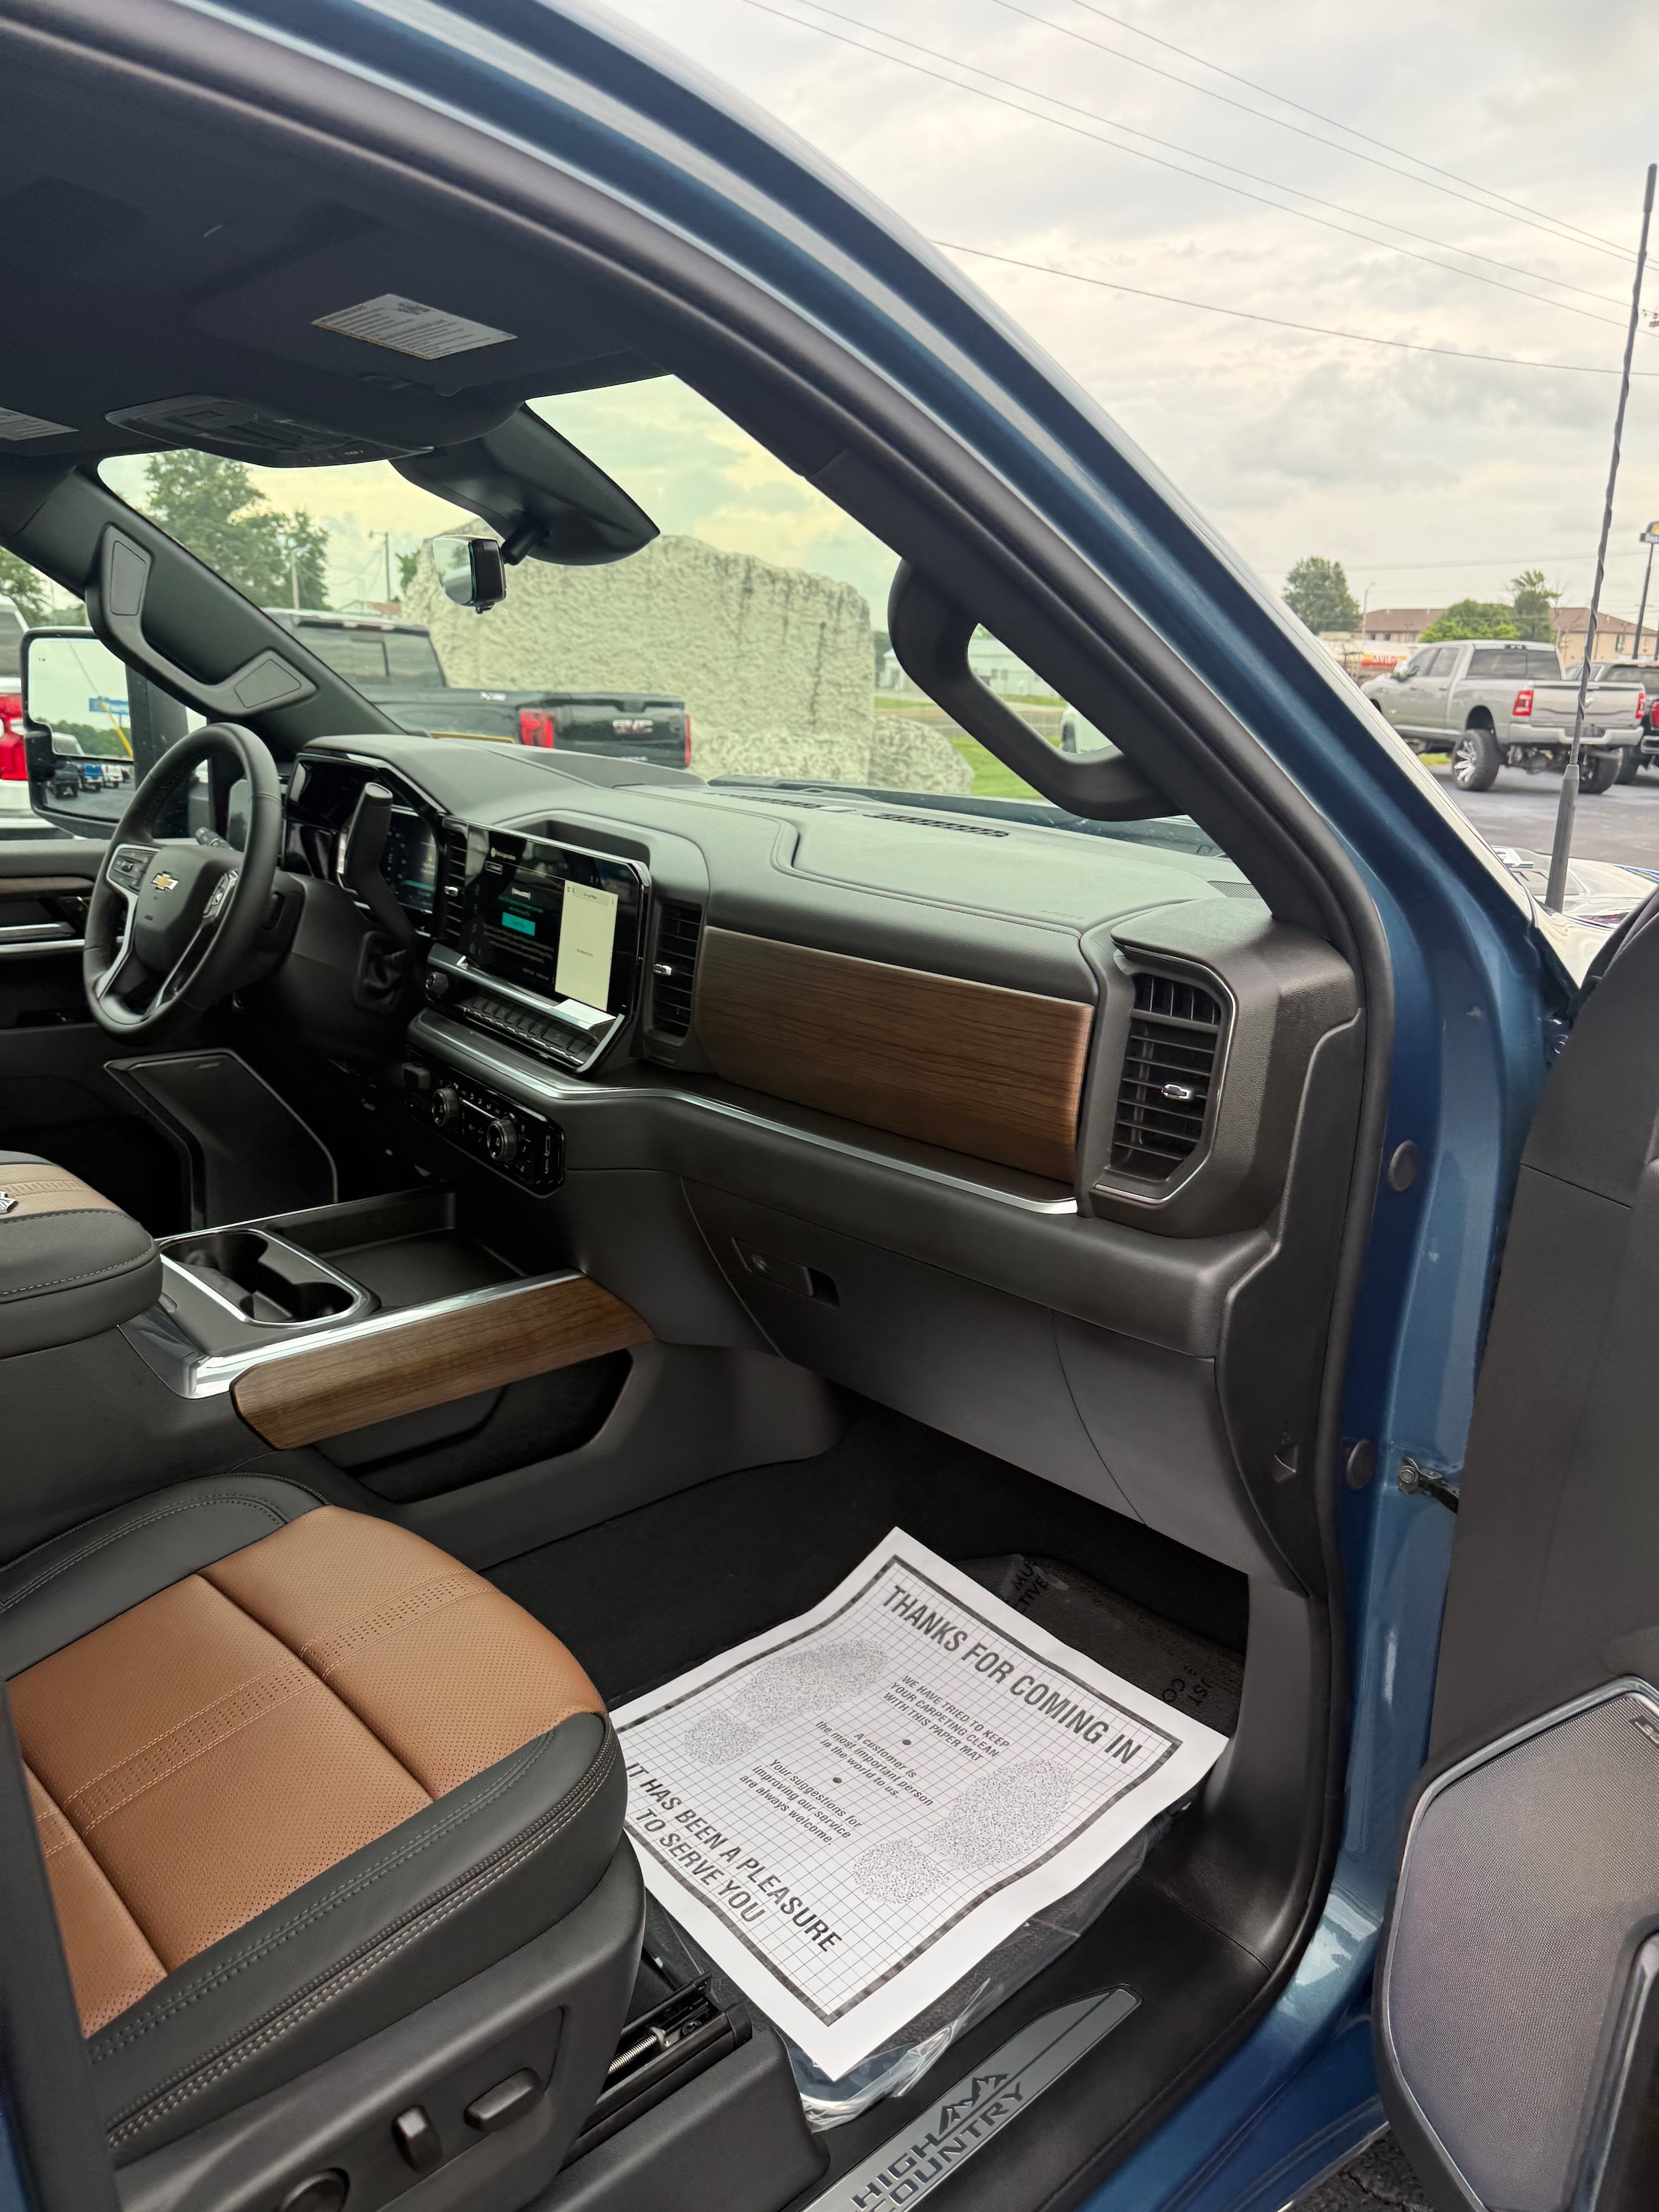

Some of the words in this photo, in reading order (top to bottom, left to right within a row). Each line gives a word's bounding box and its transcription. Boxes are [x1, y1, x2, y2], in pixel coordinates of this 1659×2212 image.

[883, 1584, 968, 1651] THANKS
[962, 1642, 1015, 1684] FOR
[1010, 1675, 1110, 1744] COMING
[1104, 1733, 1143, 1764] IN
[883, 1692, 909, 1712] WITH
[908, 1708, 931, 1726] THIS
[929, 1725, 962, 1747] PAPER
[960, 1745, 983, 1761] MAT
[891, 1682, 916, 1702] YOUR
[915, 1700, 968, 1736] CARPETING
[966, 1734, 999, 1757] CLEAN
[902, 1675, 919, 1688] WE
[916, 1686, 943, 1704] HAVE
[941, 1701, 970, 1722] TRIED
[970, 1720, 984, 1732] TO
[983, 1730, 1009, 1747] KEEP
[770, 1759, 792, 1776] Your
[790, 1775, 846, 1817] suggestions
[845, 1815, 862, 1827] for
[816, 1721, 832, 1733] the
[831, 1732, 856, 1749] most
[854, 1747, 901, 1781] important
[897, 1781, 934, 1806] person
[831, 1747, 847, 1758] the
[847, 1758, 876, 1779] world
[874, 1777, 885, 1786] to
[885, 1786, 899, 1798] us.
[863, 1739, 907, 1770] customer
[906, 1769, 916, 1778] is
[740, 1775, 757, 1788] are
[756, 1787, 789, 1811] always
[789, 1810, 832, 1845] welcome.
[753, 1765, 798, 1801] improving
[798, 1801, 816, 1812] our
[814, 1810, 851, 1838] service
[626, 1763, 649, 1777] IT
[640, 1779, 682, 1810] HAS
[675, 1809, 729, 1850] BEEN
[719, 1846, 742, 1862] A
[736, 1857, 842, 1952] PLEASURE
[636, 1808, 666, 1832] TO
[660, 1833, 725, 1885] SERVE
[718, 1880, 765, 1922] YOU
[850, 2133, 940, 2210] HIGH
